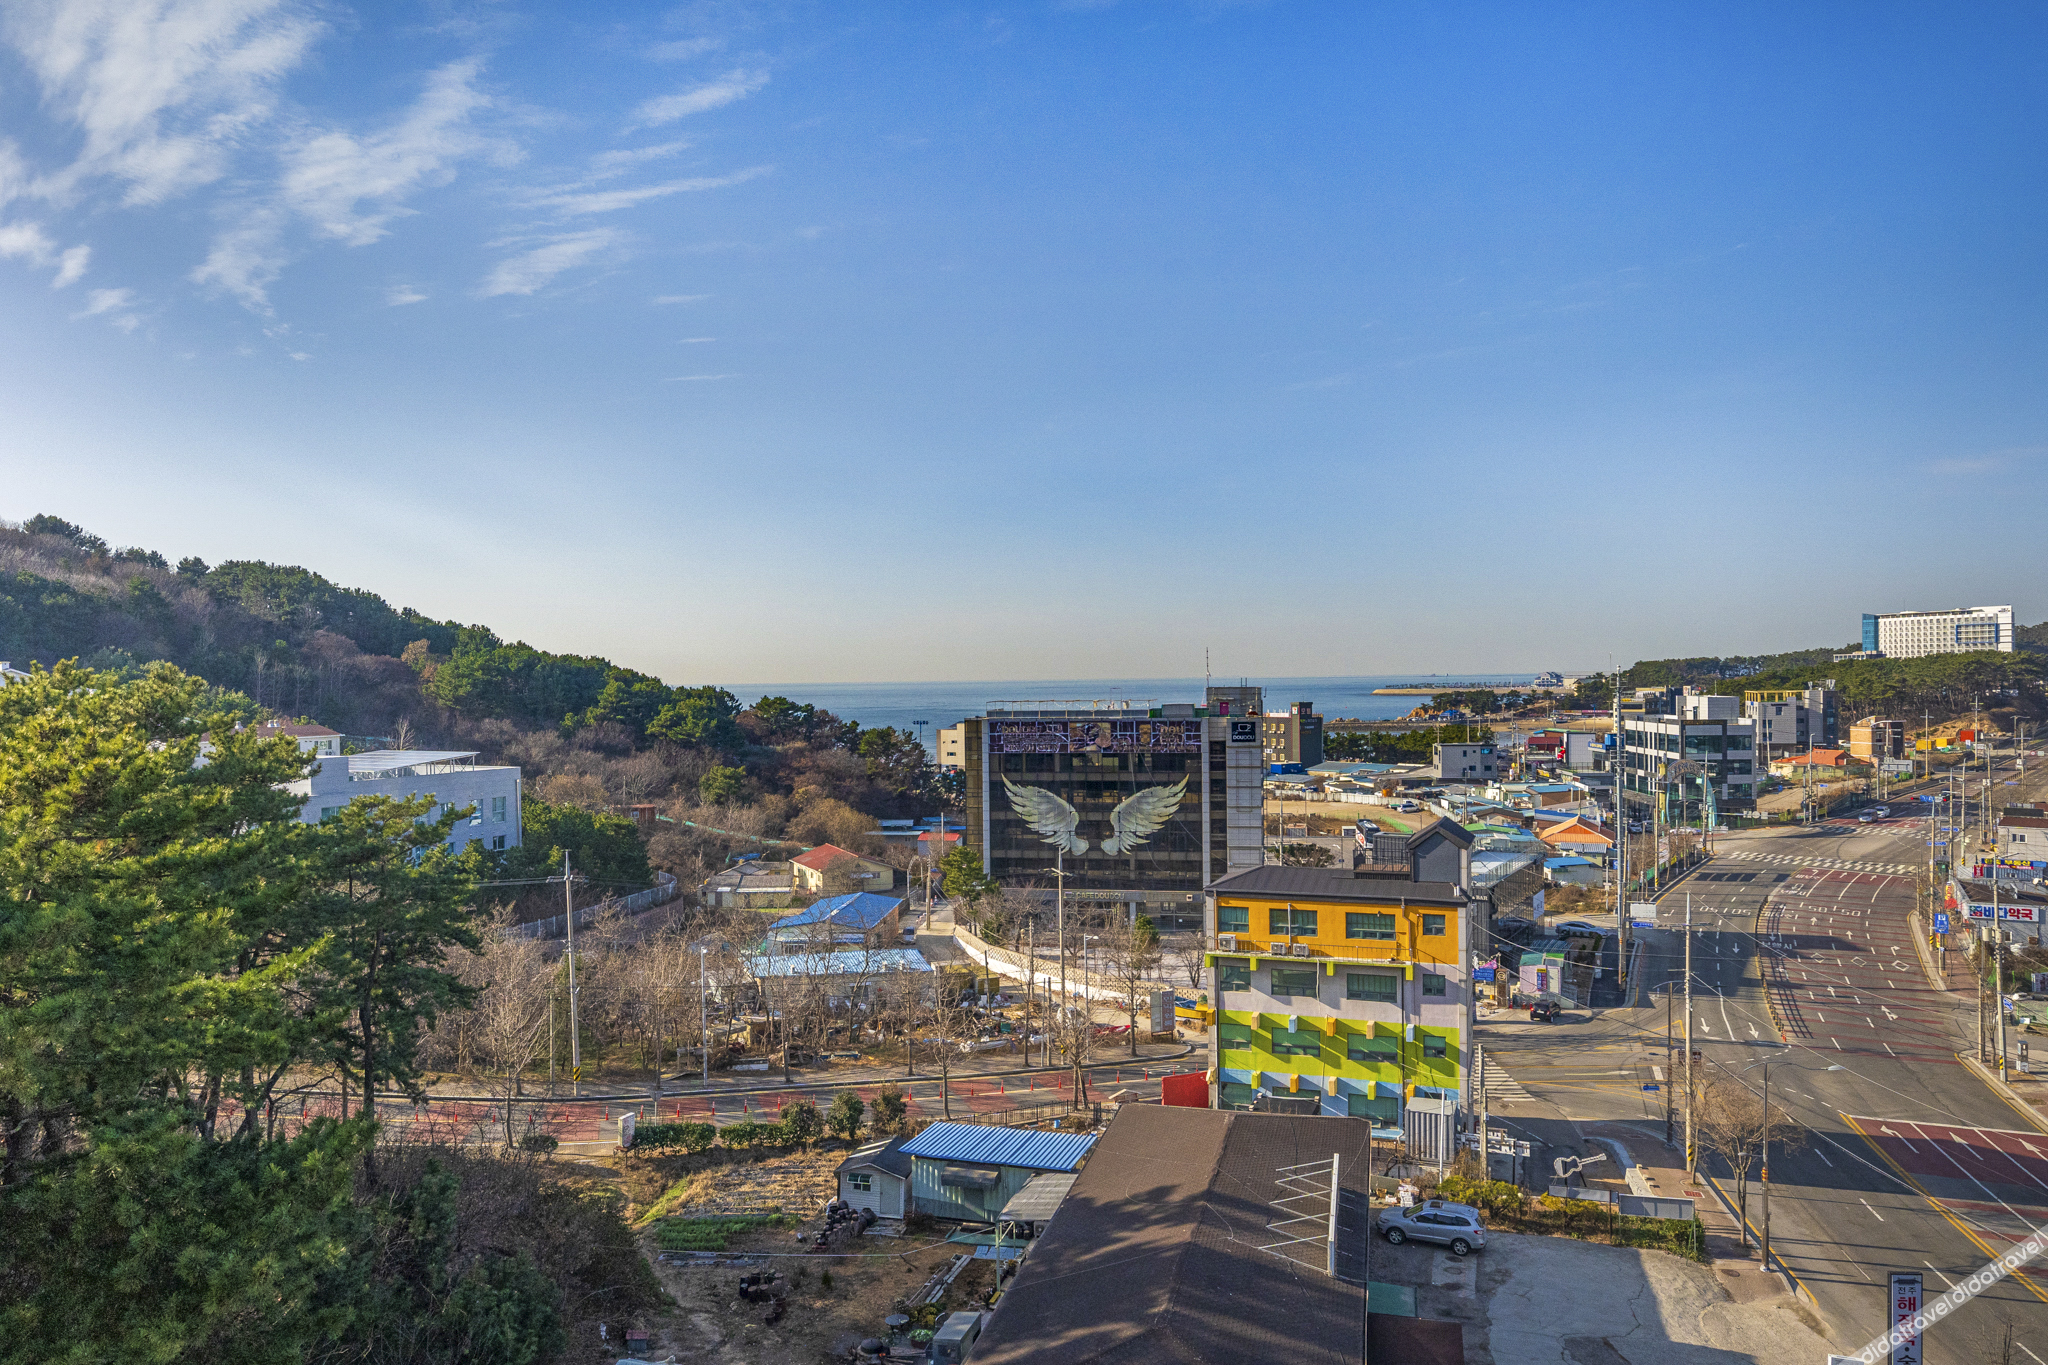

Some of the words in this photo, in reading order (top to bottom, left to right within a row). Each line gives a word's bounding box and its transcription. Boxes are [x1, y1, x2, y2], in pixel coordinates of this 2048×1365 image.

[1076, 891, 1094, 899] CAFE
[1094, 892, 1125, 900] DOUDOU
[1897, 1286, 1917, 1295] 전주
